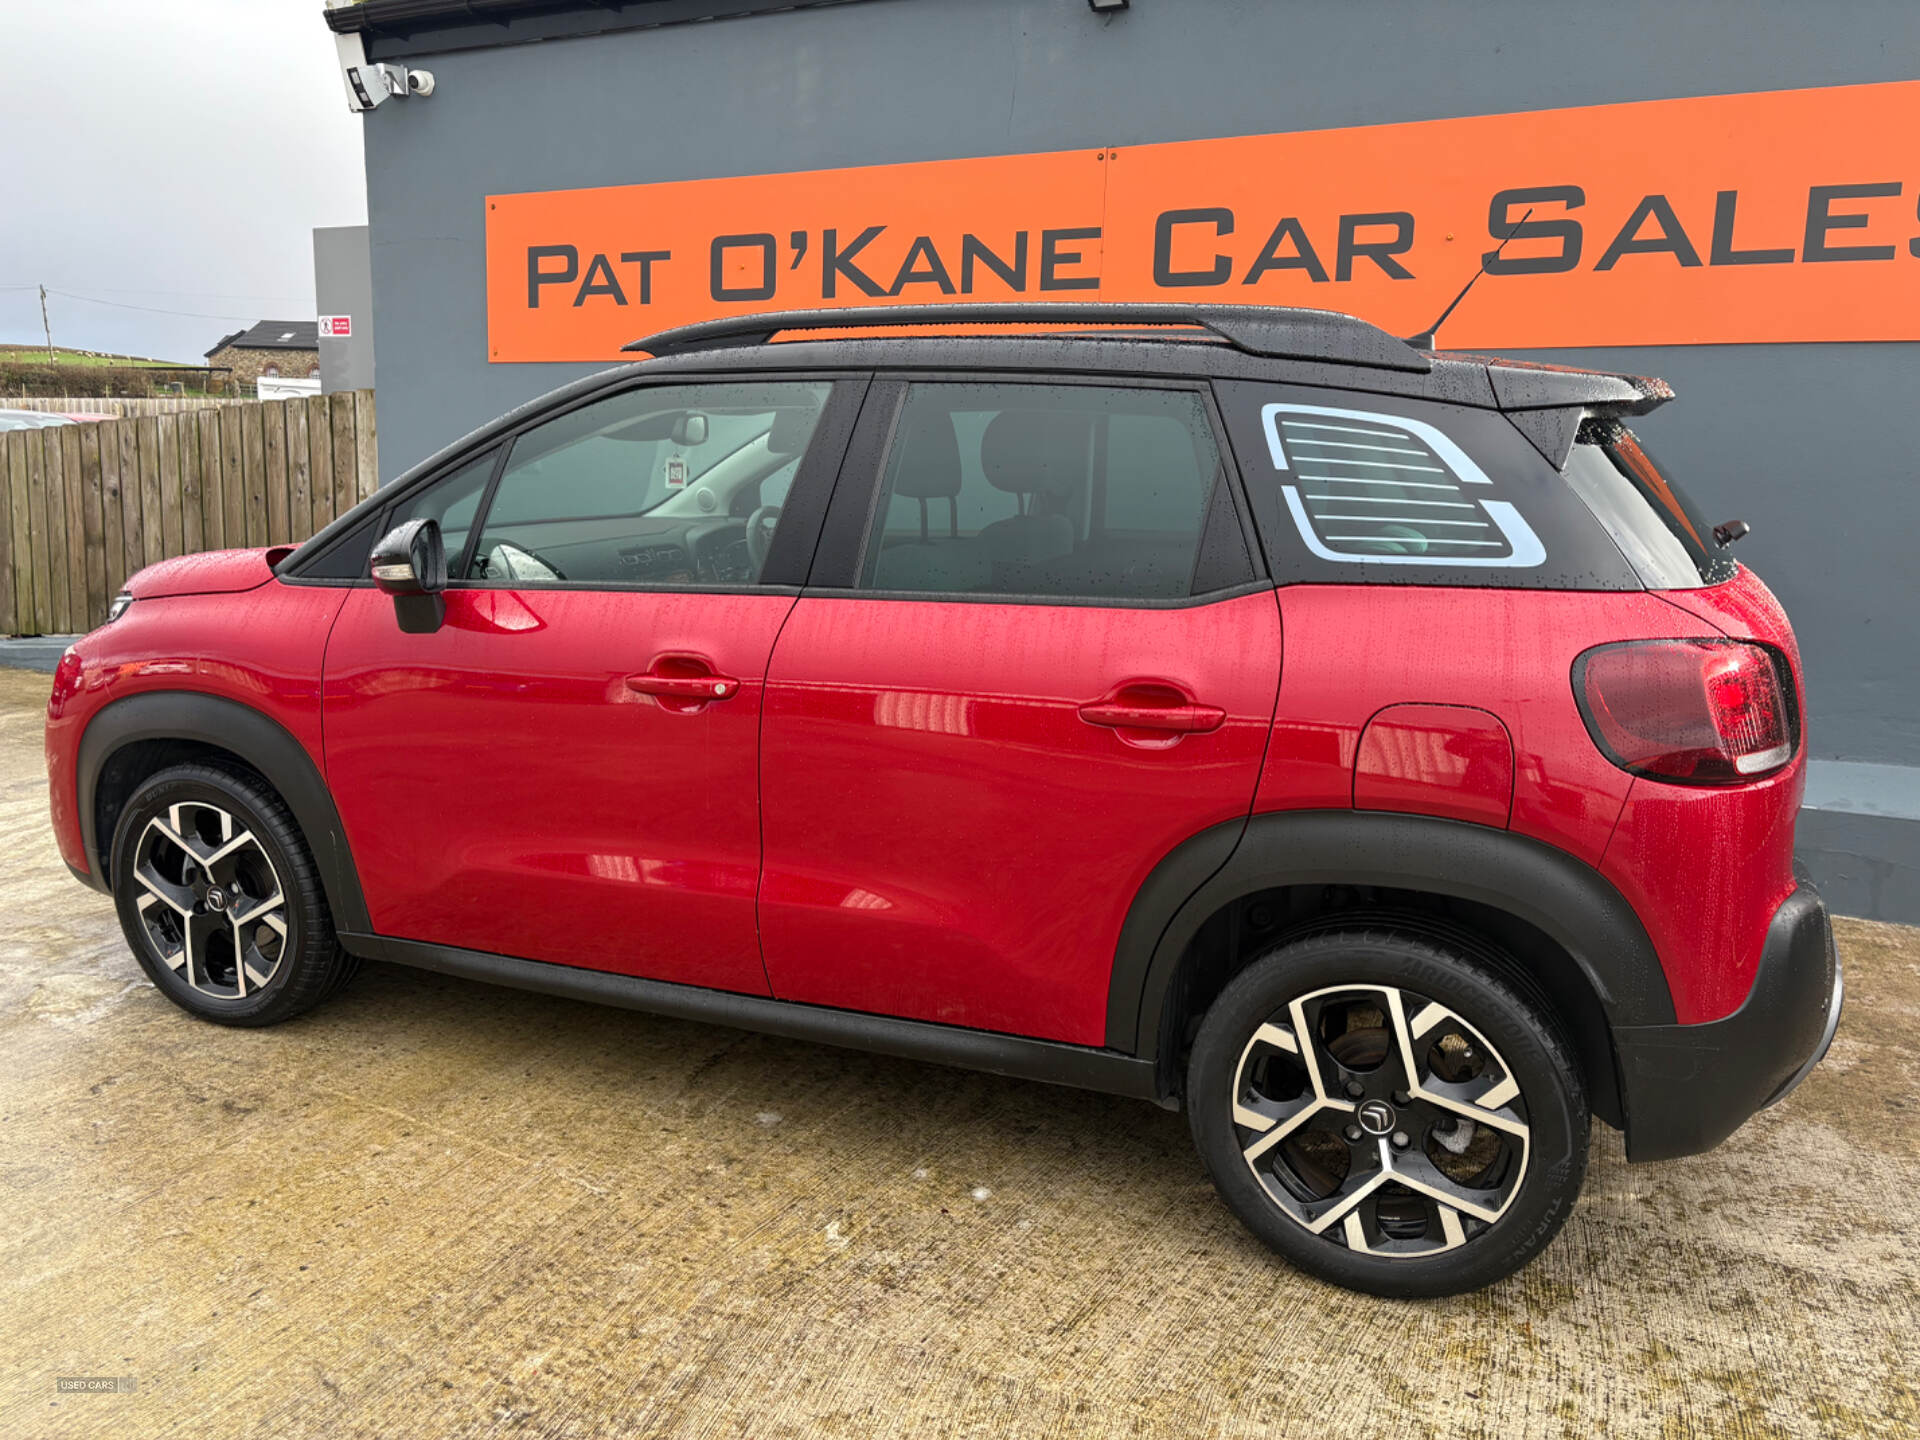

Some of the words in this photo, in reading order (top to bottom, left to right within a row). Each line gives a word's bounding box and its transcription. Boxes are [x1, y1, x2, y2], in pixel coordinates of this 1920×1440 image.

[527, 244, 671, 308] PAT
[1152, 206, 1416, 287] CAR
[1481, 181, 1920, 276] SALE
